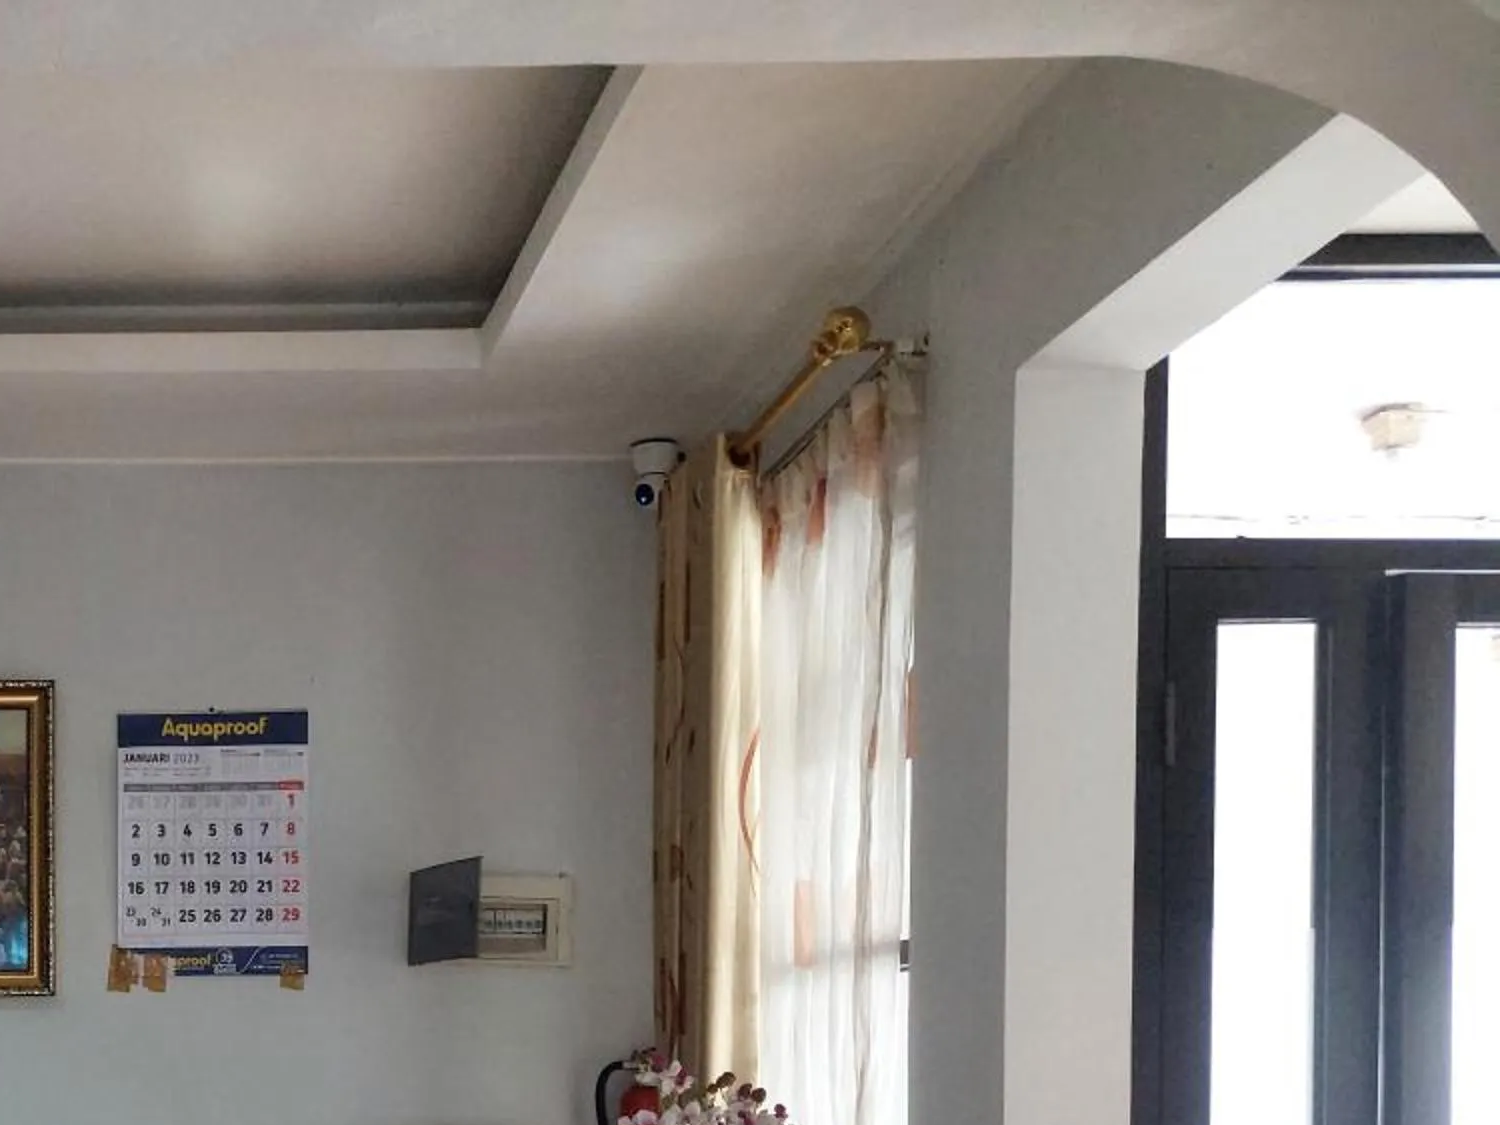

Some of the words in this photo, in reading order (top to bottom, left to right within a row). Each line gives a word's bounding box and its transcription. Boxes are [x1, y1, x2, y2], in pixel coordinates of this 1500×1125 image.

[161, 718, 269, 741] Aquaproof
[123, 752, 170, 763] JANUARI
[288, 794, 294, 808] 1
[131, 825, 141, 838] 2
[157, 824, 166, 838] 3
[183, 824, 192, 837] 4
[208, 824, 217, 837] 5
[233, 824, 243, 837] 6
[260, 823, 269, 836] 7
[287, 823, 295, 835] 8
[131, 853, 140, 867] 9
[154, 853, 170, 866] 10
[180, 853, 195, 866] 11
[205, 852, 221, 865] 12
[231, 852, 247, 865] 13
[257, 852, 273, 864] 14
[283, 851, 299, 864] 15
[128, 882, 144, 895] 16
[155, 882, 169, 895] 17
[180, 881, 195, 894] 18
[205, 881, 221, 894] 19
[229, 880, 248, 893] 20
[257, 880, 273, 893] 21
[282, 880, 300, 893] 22
[179, 910, 196, 923] 25
[204, 909, 221, 923] 26
[230, 909, 247, 923] 27
[256, 909, 273, 922] 28
[282, 908, 299, 921] 29
